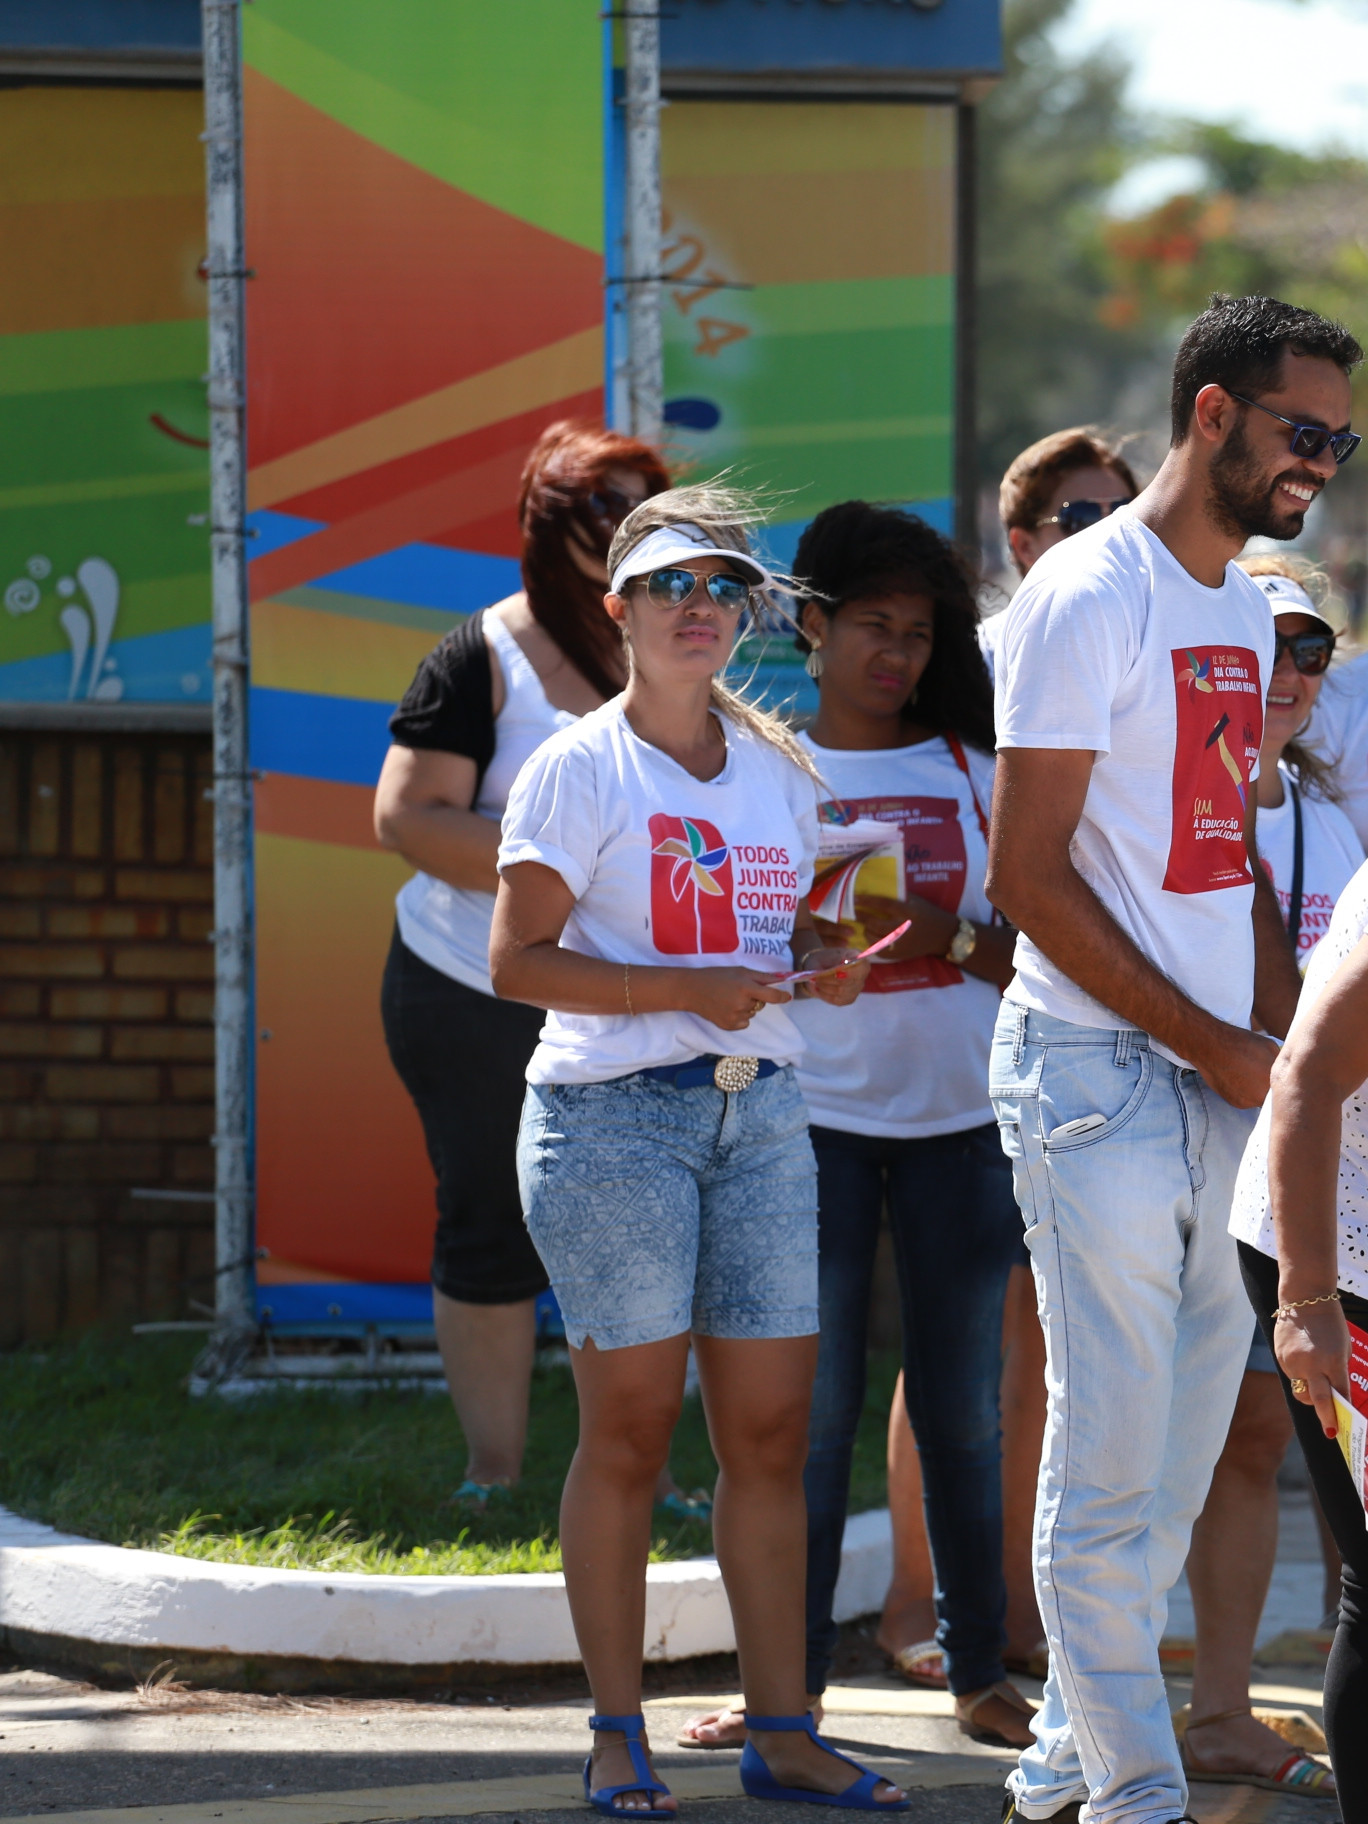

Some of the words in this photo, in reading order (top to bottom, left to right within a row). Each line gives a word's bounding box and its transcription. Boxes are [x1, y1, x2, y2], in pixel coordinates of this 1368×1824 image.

[1192, 797, 1213, 817] SIM
[1195, 830, 1206, 840] DE
[732, 845, 790, 866] TODOS
[738, 868, 797, 889] JUNTOS
[737, 892, 797, 912] CONTRA
